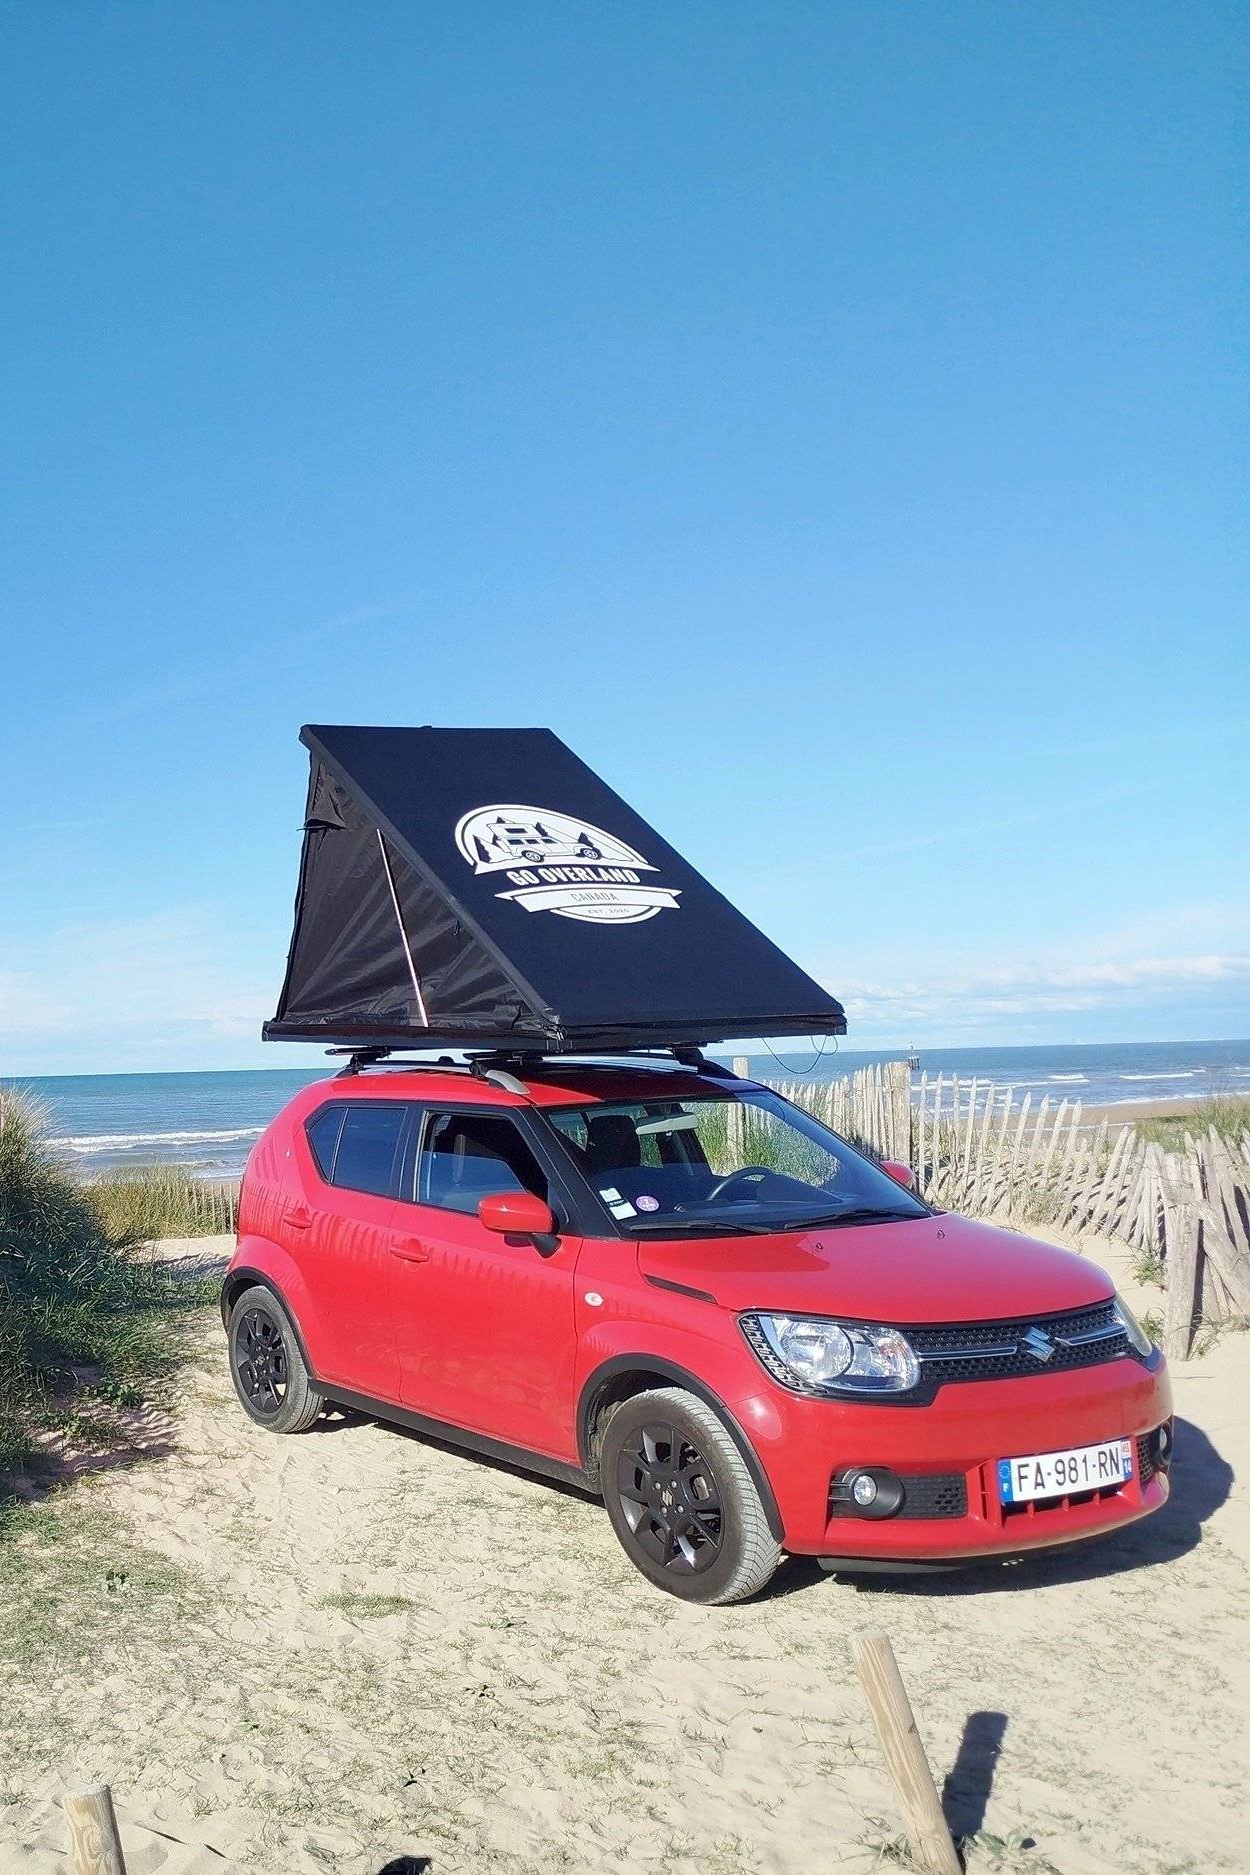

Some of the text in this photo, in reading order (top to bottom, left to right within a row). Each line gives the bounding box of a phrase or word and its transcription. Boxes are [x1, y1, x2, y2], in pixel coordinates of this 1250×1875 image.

[506, 867, 641, 886] GO OVERLAND
[570, 892, 620, 903] CANADA
[1017, 1448, 1121, 1492] FA-981-RN
